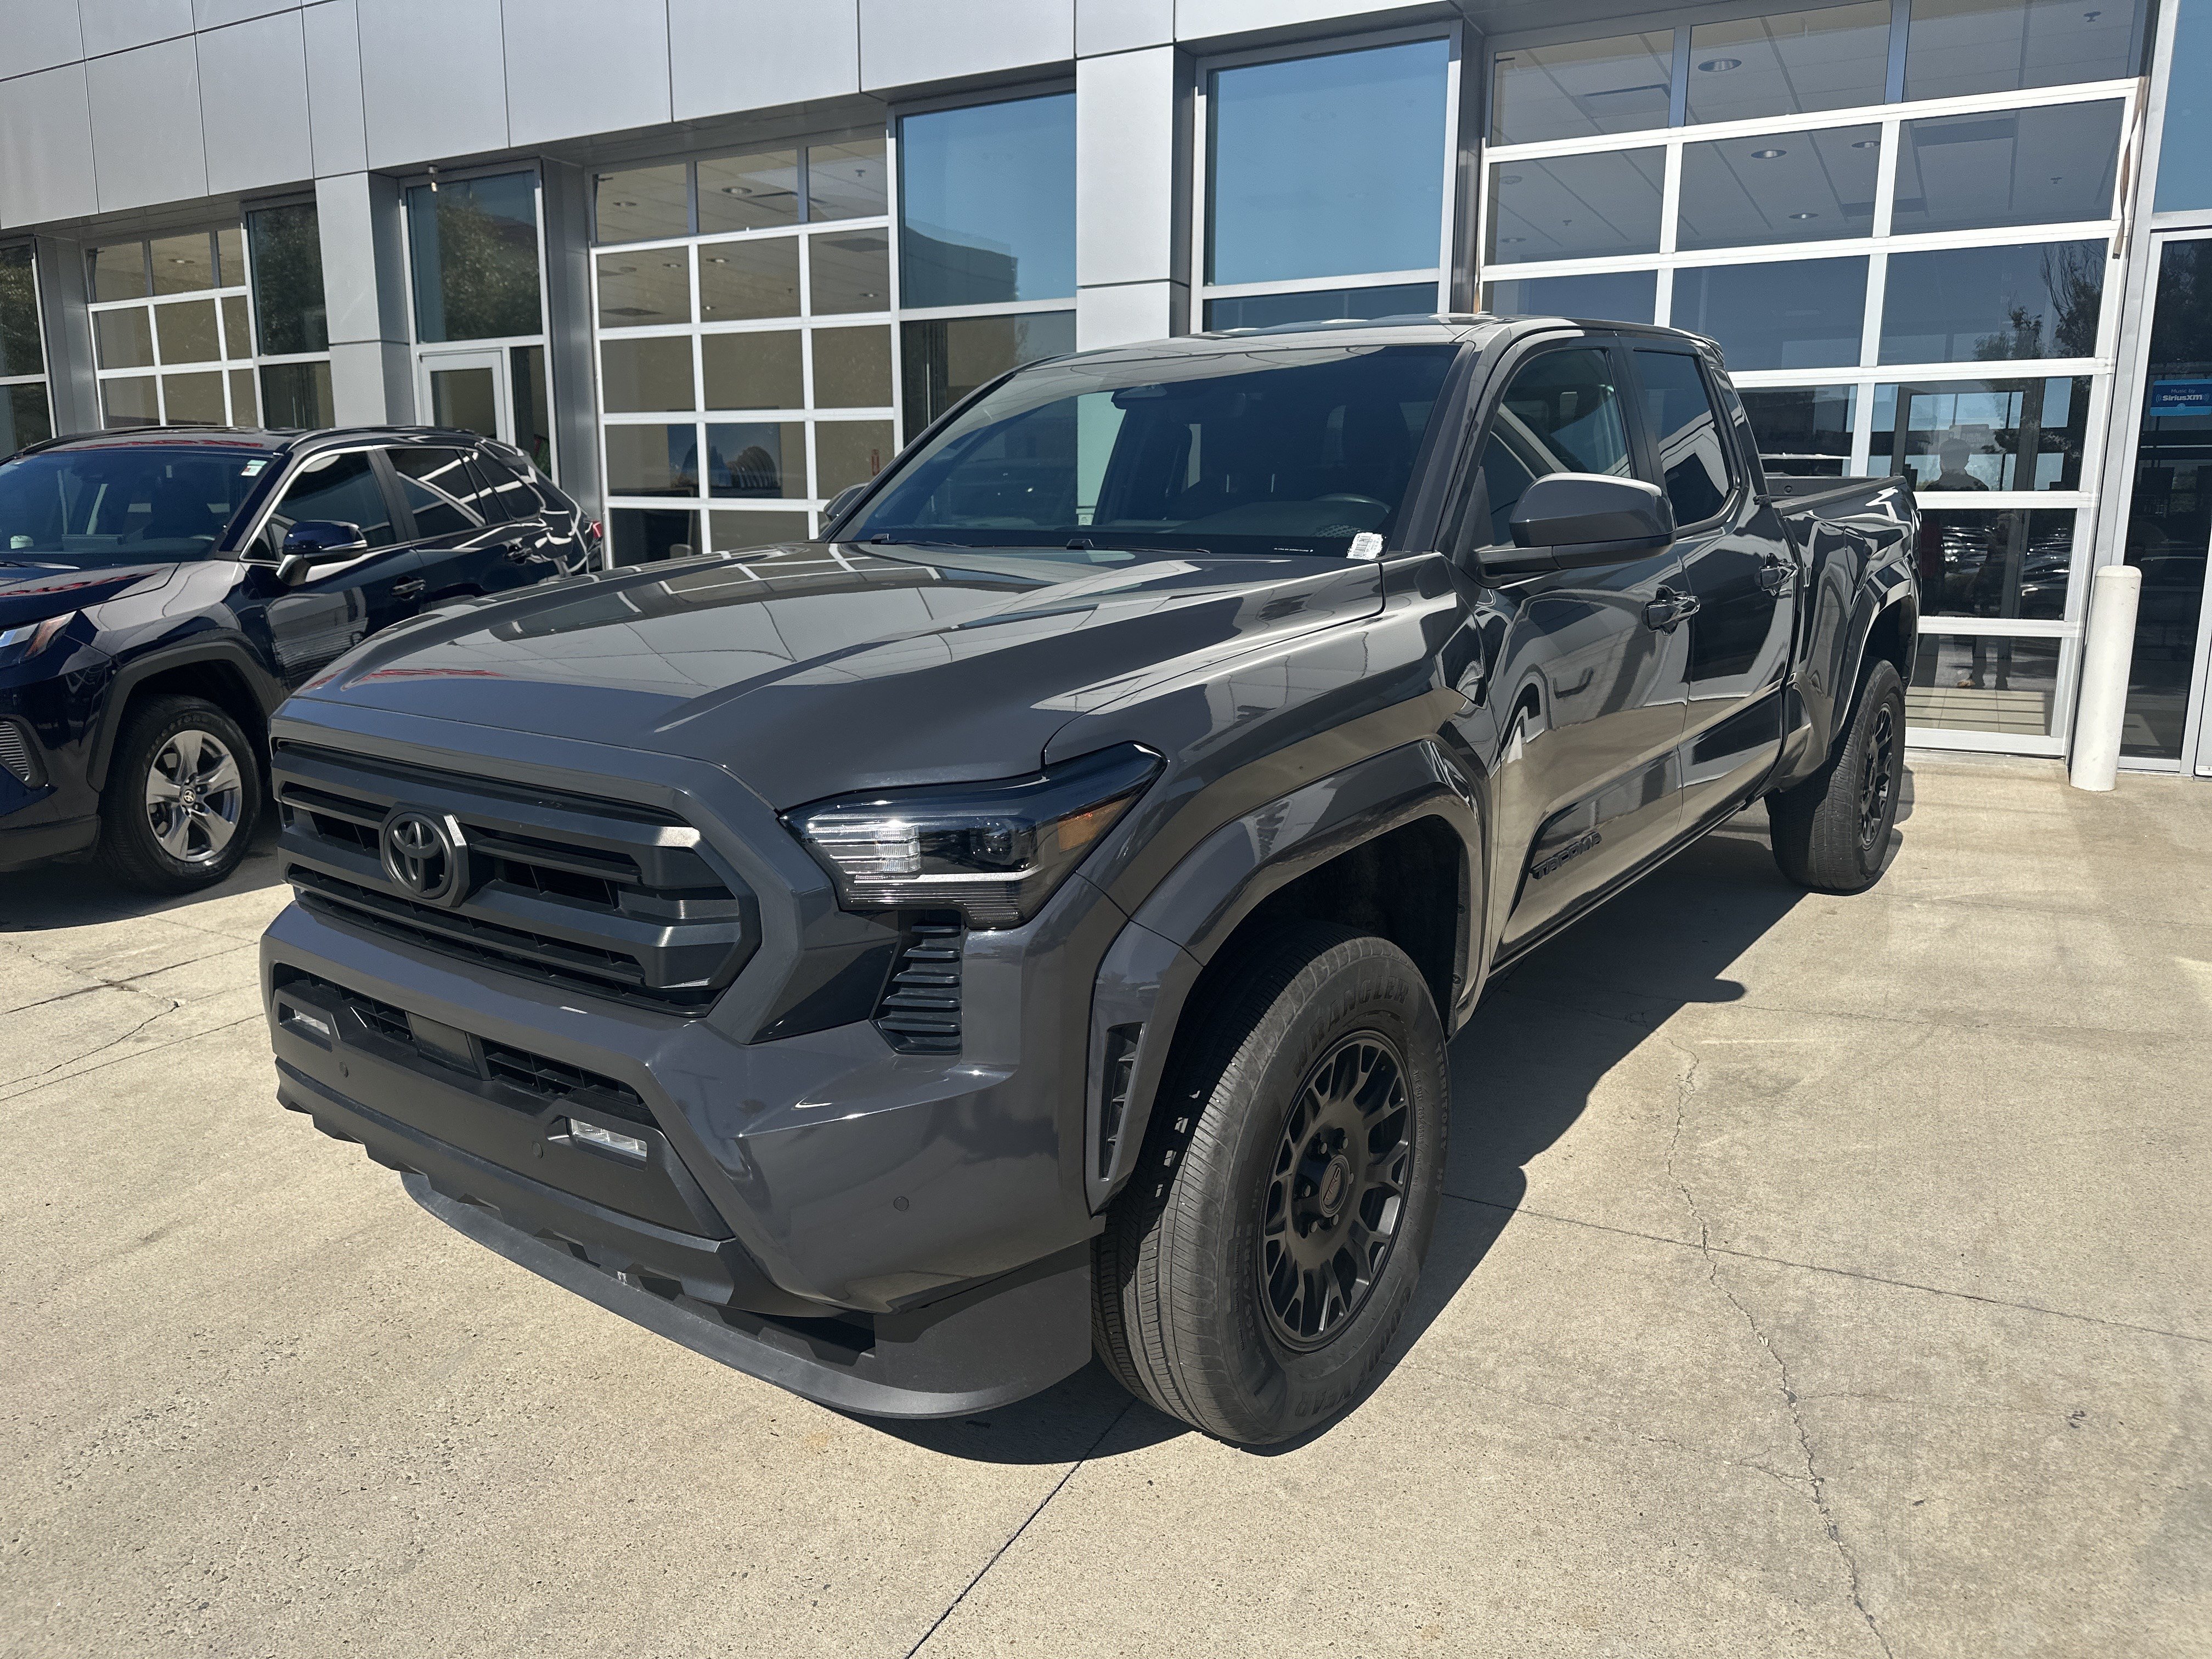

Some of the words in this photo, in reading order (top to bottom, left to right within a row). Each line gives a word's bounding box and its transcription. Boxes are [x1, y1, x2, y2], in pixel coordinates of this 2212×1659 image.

[1530, 832, 1602, 879] TACOMA
[1289, 975, 1410, 1079] WRANGLER
[1435, 1042, 1448, 1154] TERRITORY
[1435, 1168, 1443, 1195] HT
[1294, 1285, 1412, 1418] GOODYEAR
